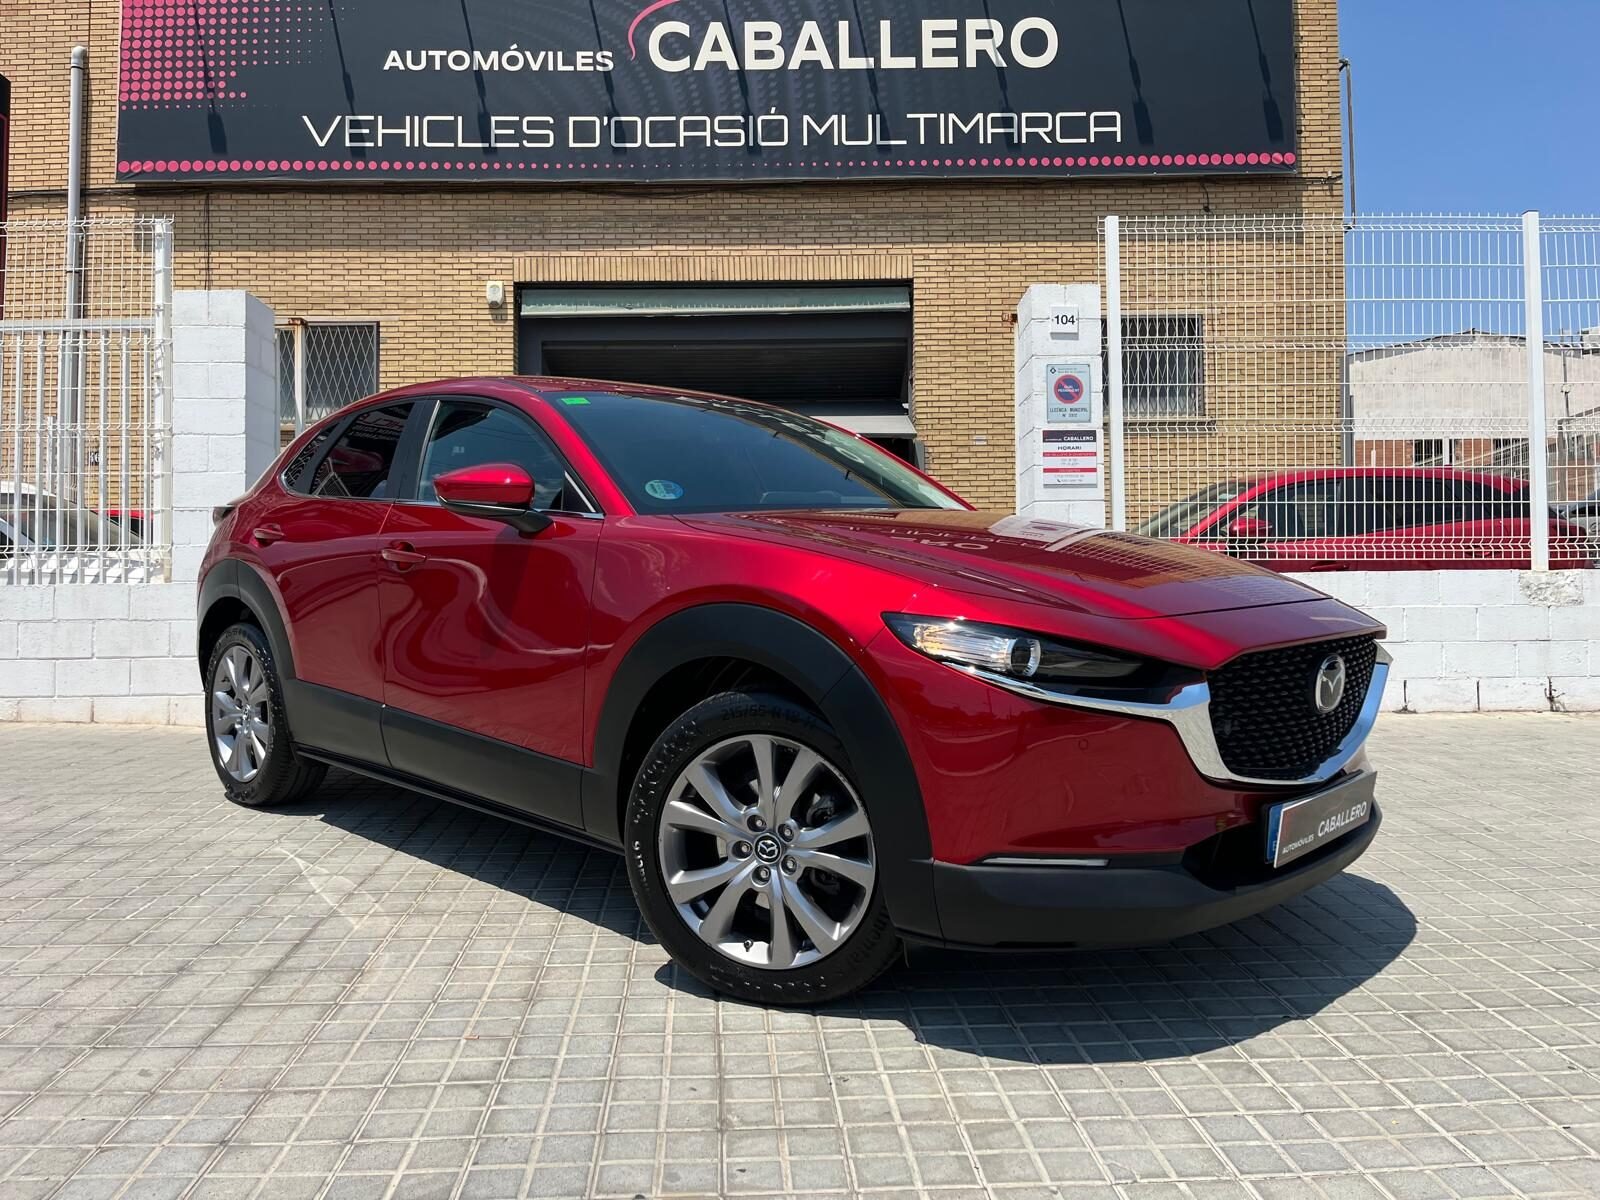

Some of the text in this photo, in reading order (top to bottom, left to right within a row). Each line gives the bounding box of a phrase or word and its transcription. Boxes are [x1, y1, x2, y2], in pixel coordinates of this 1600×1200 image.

[383, 17, 1059, 72] AUTOMÓVILES CABALLERO
[302, 106, 1122, 148] VEHICLES D'OCASIÓ MULTIMARCA
[1054, 314, 1075, 325] 104
[1317, 801, 1367, 837] CABALLERO
